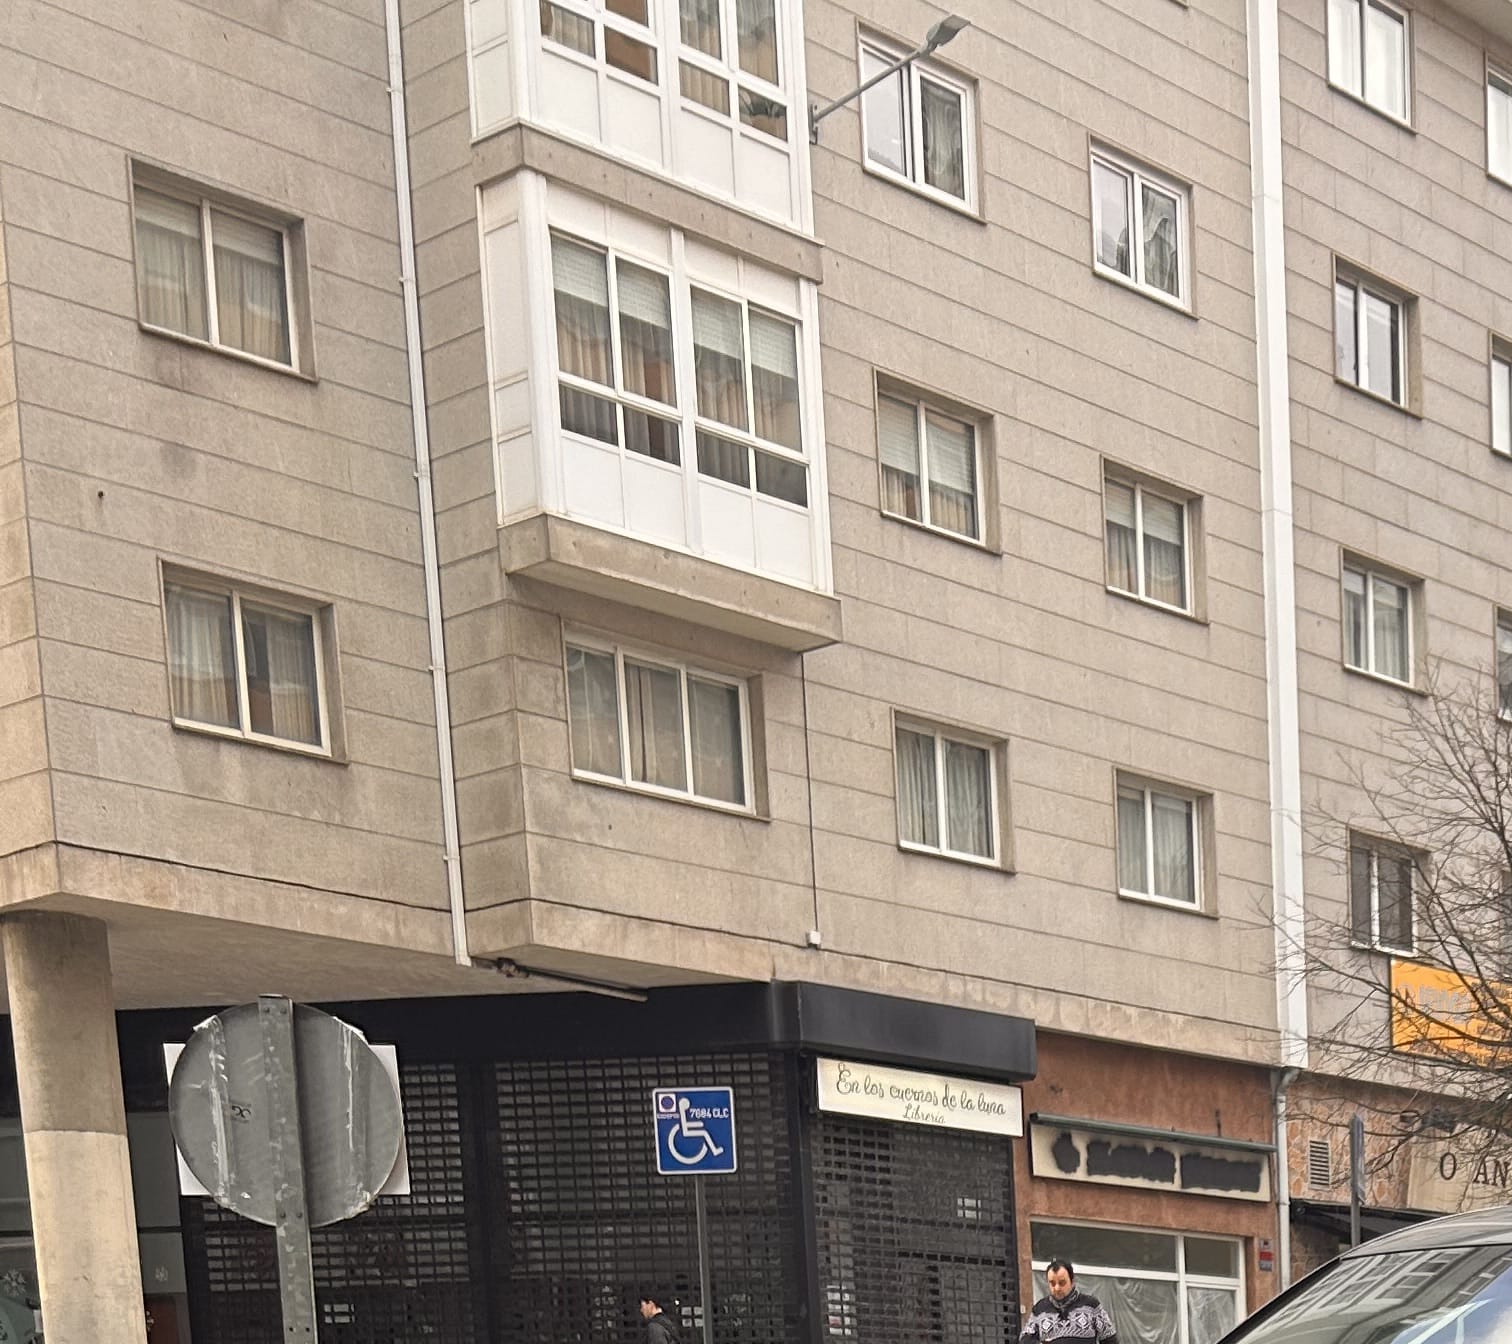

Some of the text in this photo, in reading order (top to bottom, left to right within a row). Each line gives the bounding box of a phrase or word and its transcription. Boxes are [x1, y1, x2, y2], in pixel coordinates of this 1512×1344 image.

[836, 1063, 1007, 1115] En los cuernos de la luna
[1439, 1152, 1457, 1181] O
